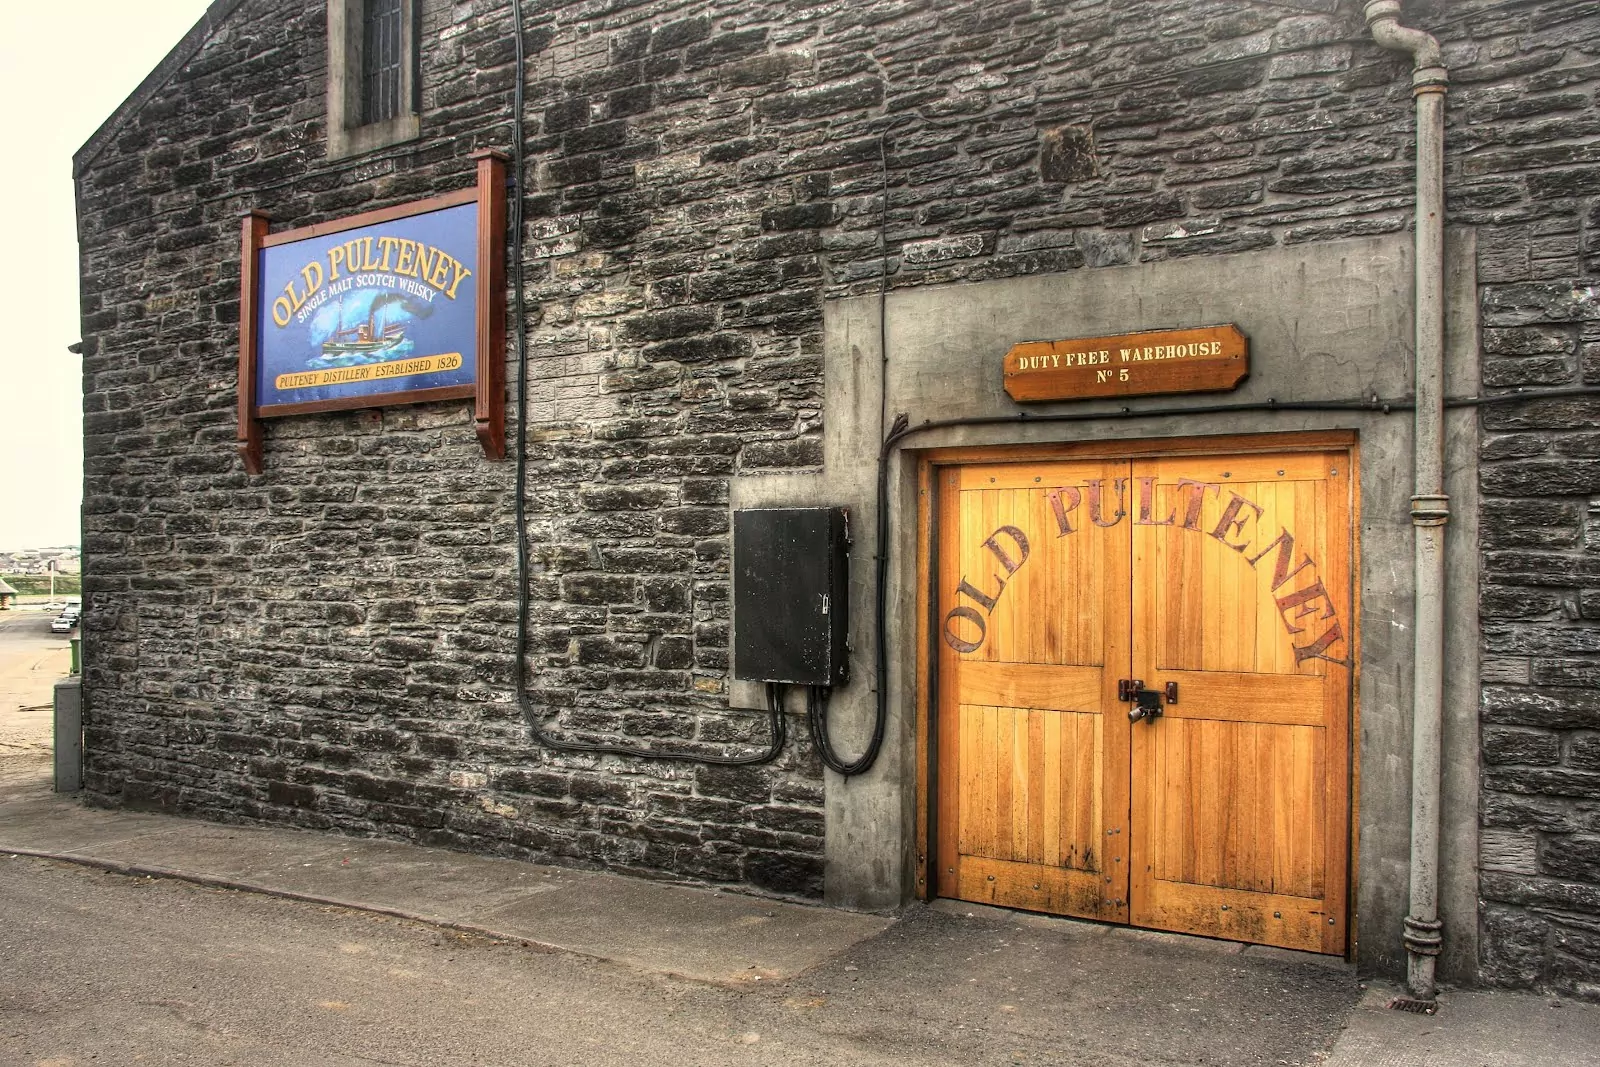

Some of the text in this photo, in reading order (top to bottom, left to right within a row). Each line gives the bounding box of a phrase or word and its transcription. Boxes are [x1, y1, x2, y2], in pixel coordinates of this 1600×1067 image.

[272, 236, 472, 327] OLD PULTENEY
[297, 273, 437, 324] SINGLE MALT SCOTCH WHISKY
[280, 356, 458, 388] PULTENEY DISTILLERY ESTABLISHED 1826
[1019, 341, 1222, 370] DUTY FREE WAREHOUSE
[1119, 368, 1130, 382] 5
[943, 475, 1354, 669] OLD PULTENEY
